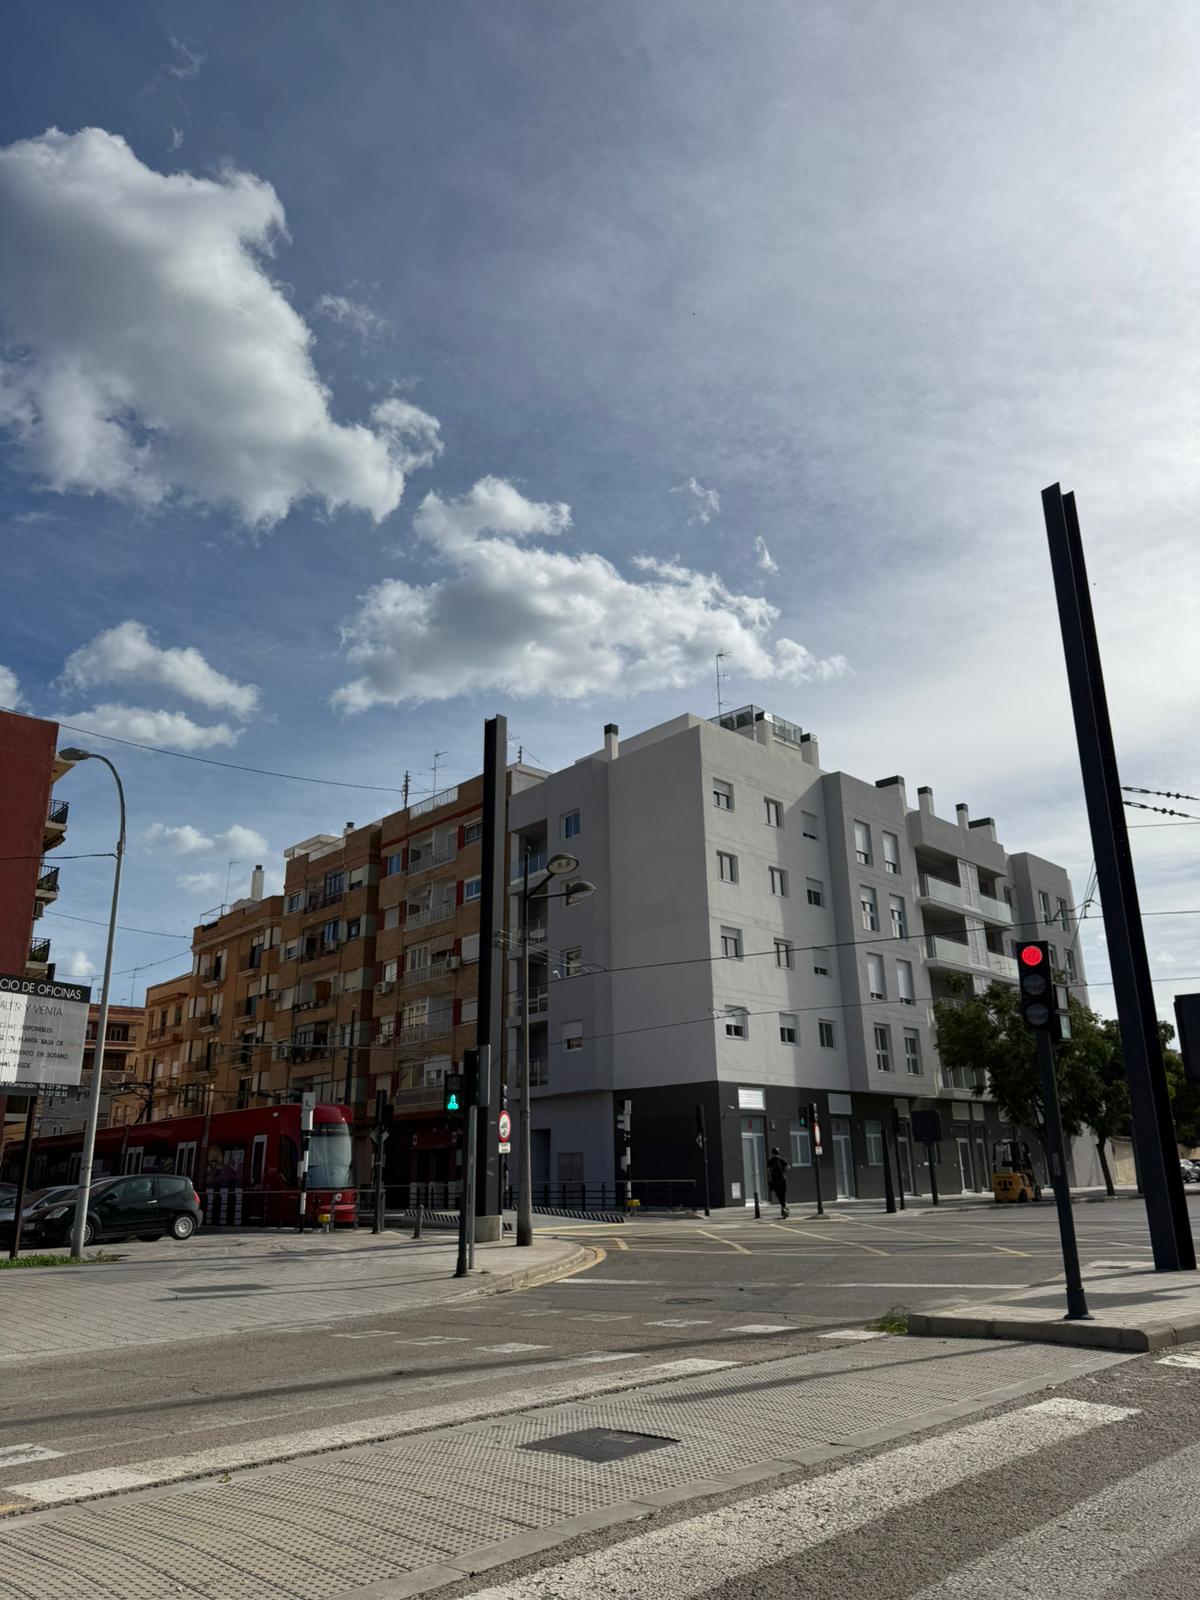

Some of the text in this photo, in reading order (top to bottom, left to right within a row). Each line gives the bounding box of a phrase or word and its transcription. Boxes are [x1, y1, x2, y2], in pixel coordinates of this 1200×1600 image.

[22, 981, 36, 993] DE
[37, 984, 81, 1000] OFICINAS
[34, 1005, 63, 1017] VENTA
